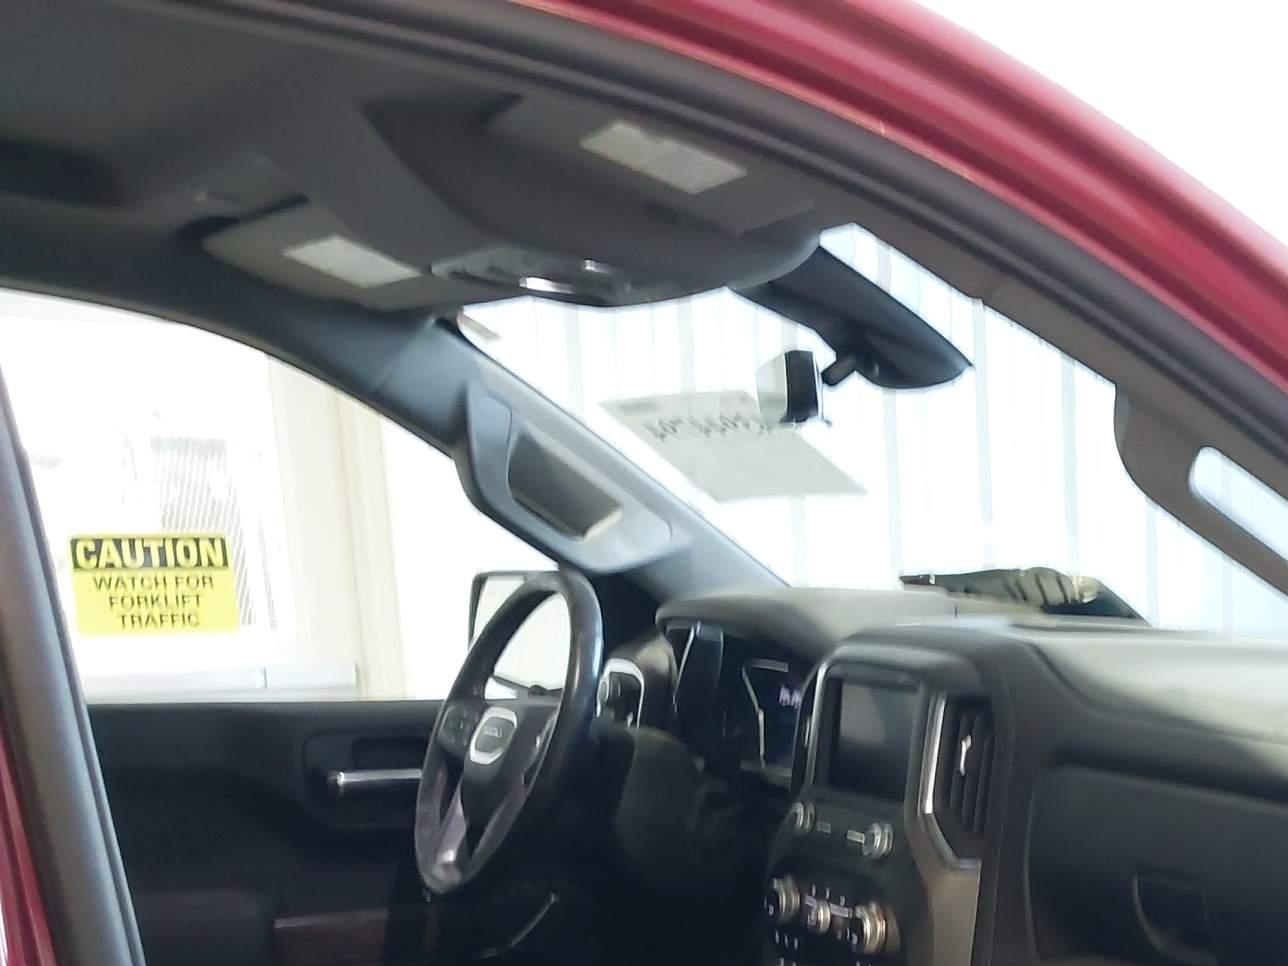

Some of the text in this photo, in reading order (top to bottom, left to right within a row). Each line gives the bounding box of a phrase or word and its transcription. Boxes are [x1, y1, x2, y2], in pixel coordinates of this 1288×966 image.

[75, 538, 225, 569] CAUTION
[93, 575, 215, 593] WATCH FOR
[108, 594, 202, 610] FORKLIFT
[117, 613, 200, 629] TRAFFIC
